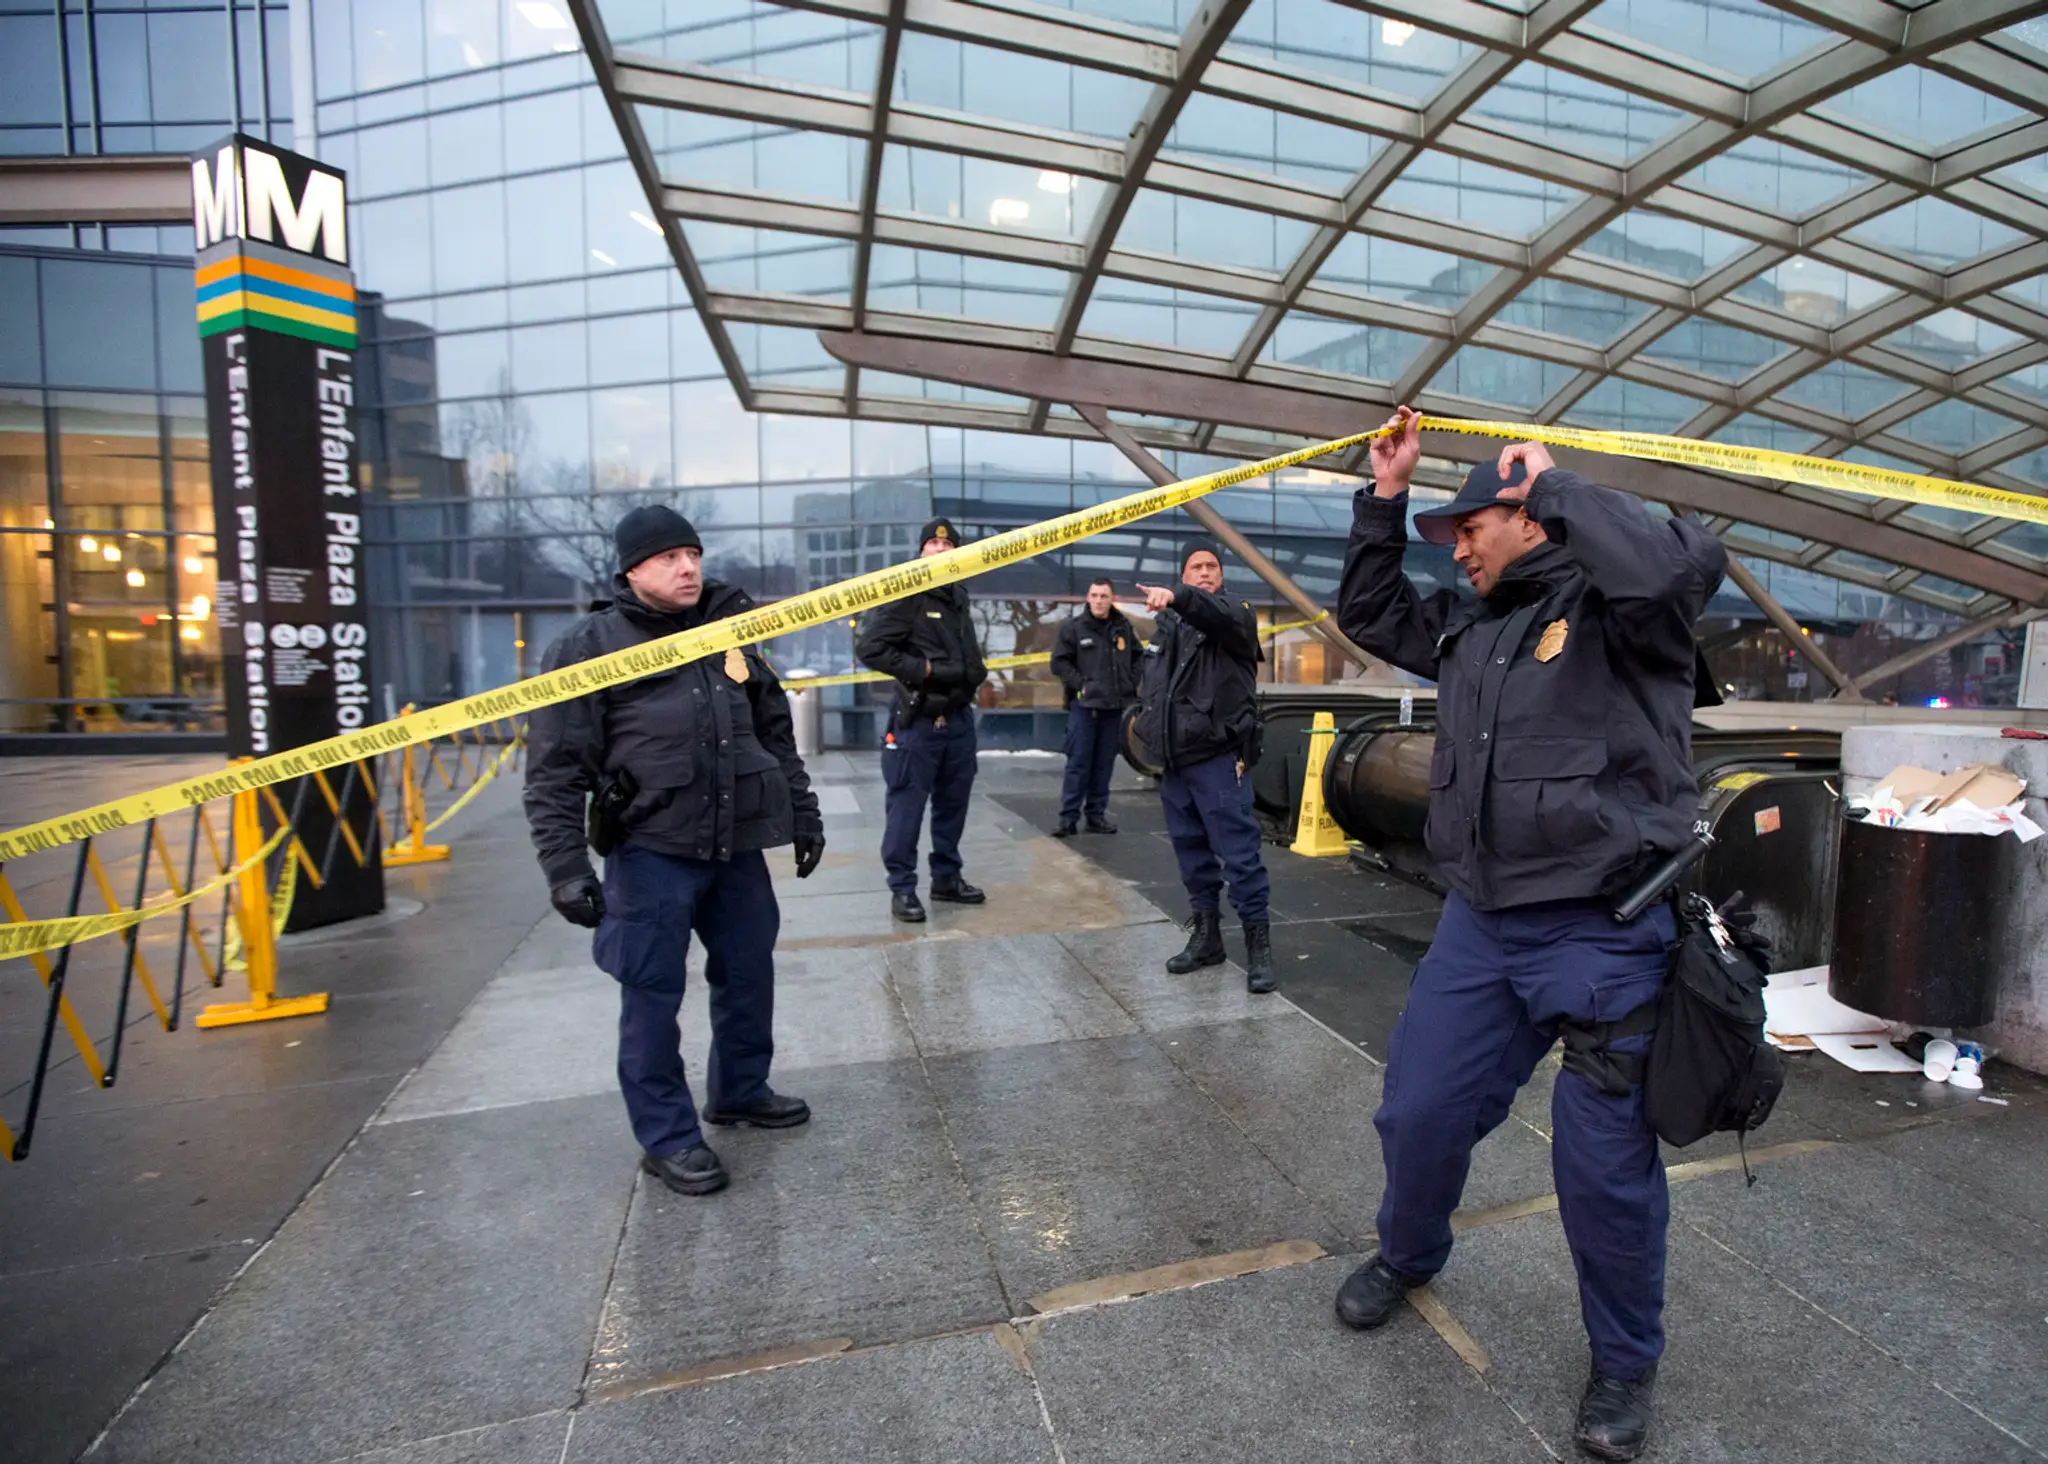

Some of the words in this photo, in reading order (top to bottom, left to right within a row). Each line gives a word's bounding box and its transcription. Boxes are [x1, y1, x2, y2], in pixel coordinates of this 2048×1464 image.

[192, 145, 246, 250] M
[243, 146, 348, 264] M
[226, 333, 254, 490] L'Enfant
[317, 348, 358, 497] L'Enfant
[236, 506, 258, 604] Plaza
[325, 511, 361, 606] Plaza
[244, 620, 270, 751] Station
[331, 621, 370, 735] Statio
